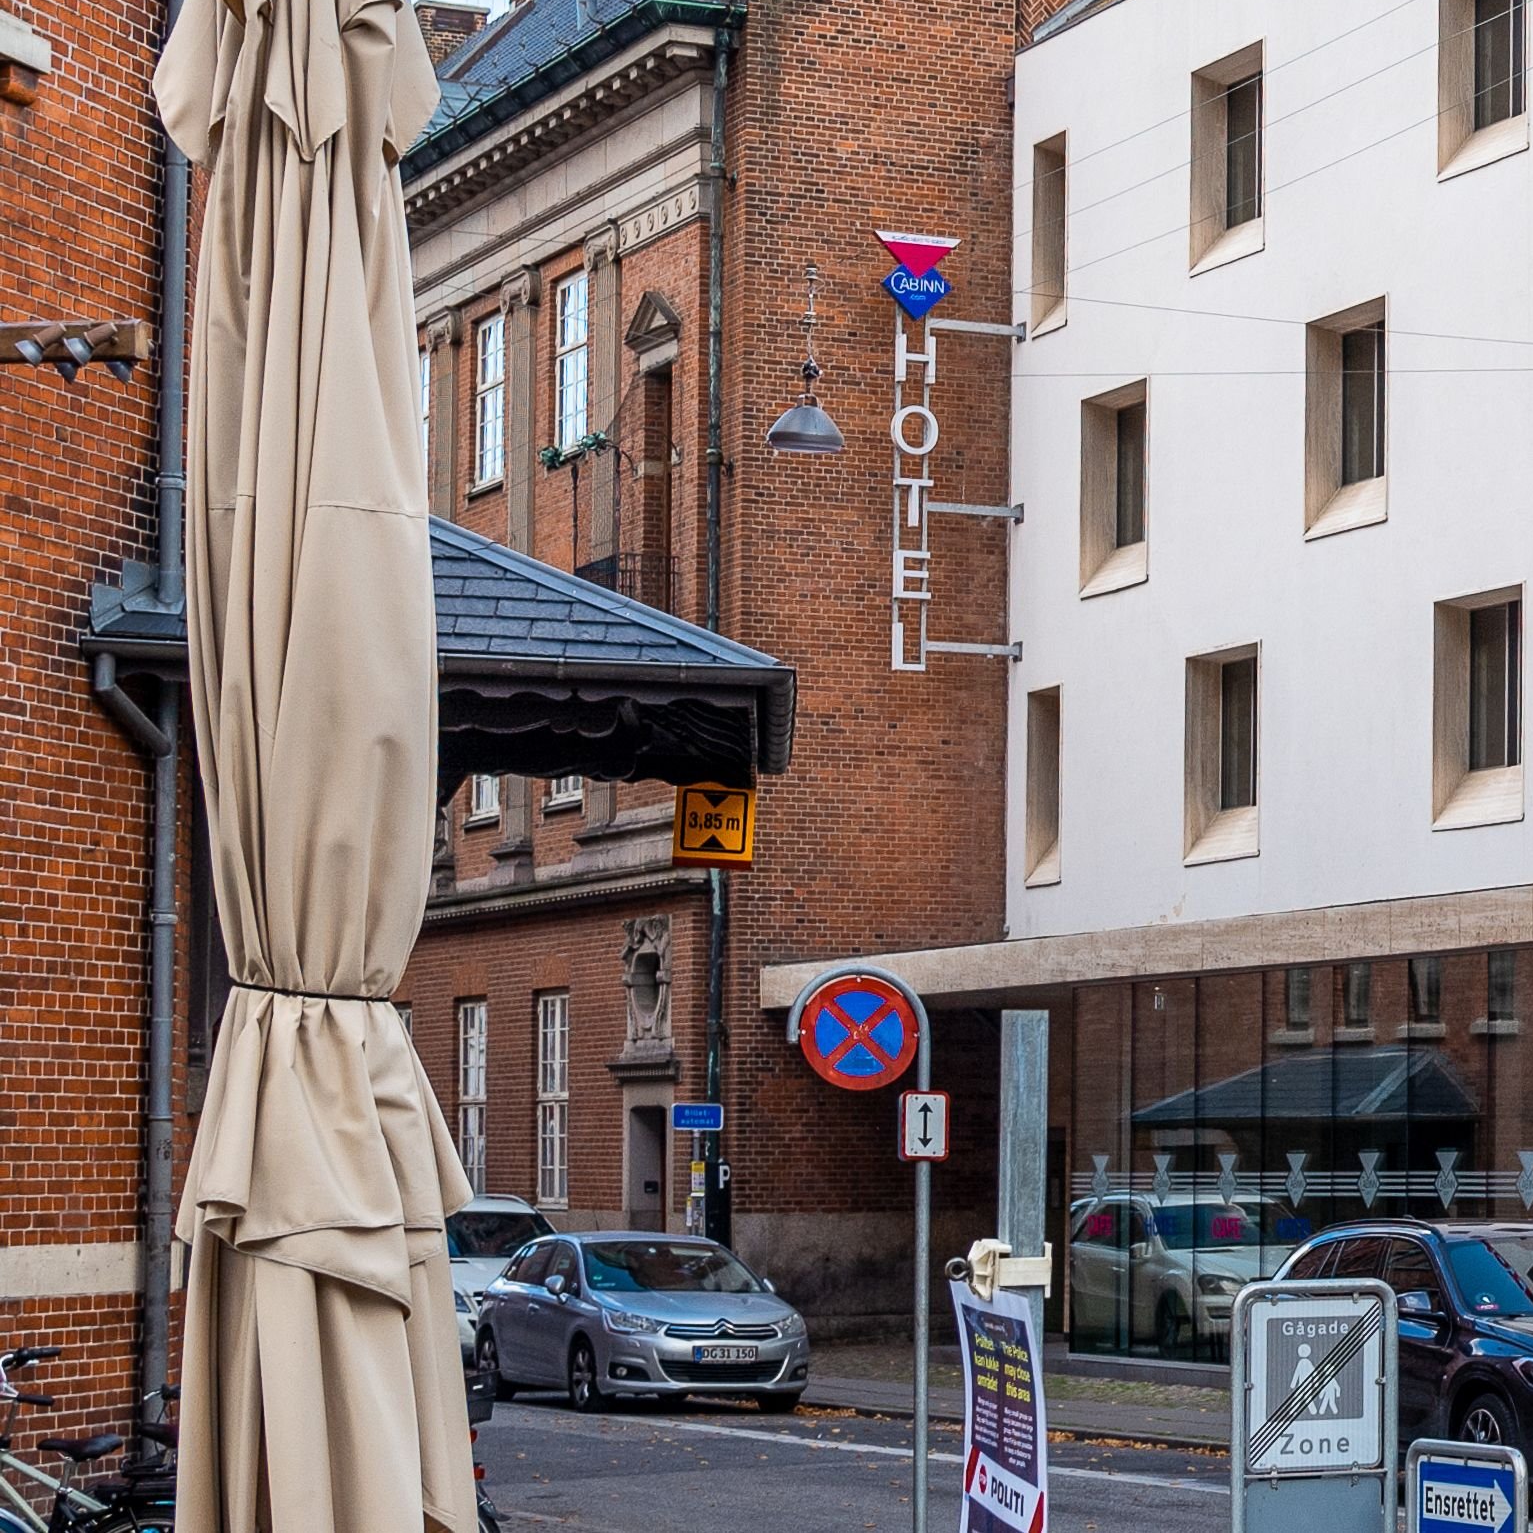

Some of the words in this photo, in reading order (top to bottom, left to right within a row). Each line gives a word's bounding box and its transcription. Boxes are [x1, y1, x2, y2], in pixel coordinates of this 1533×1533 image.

[890, 271, 945, 294] CABINN
[891, 333, 939, 671] HOTEL
[688, 811, 723, 831] 3,85
[726, 817, 740, 831] m
[719, 1165, 730, 1189] P
[1282, 1321, 1349, 1337] Gågade
[736, 1348, 755, 1359] 150
[1280, 1433, 1350, 1455] Zone
[991, 1476, 1025, 1517] POLITI
[1425, 1486, 1495, 1522] Ensrettet
